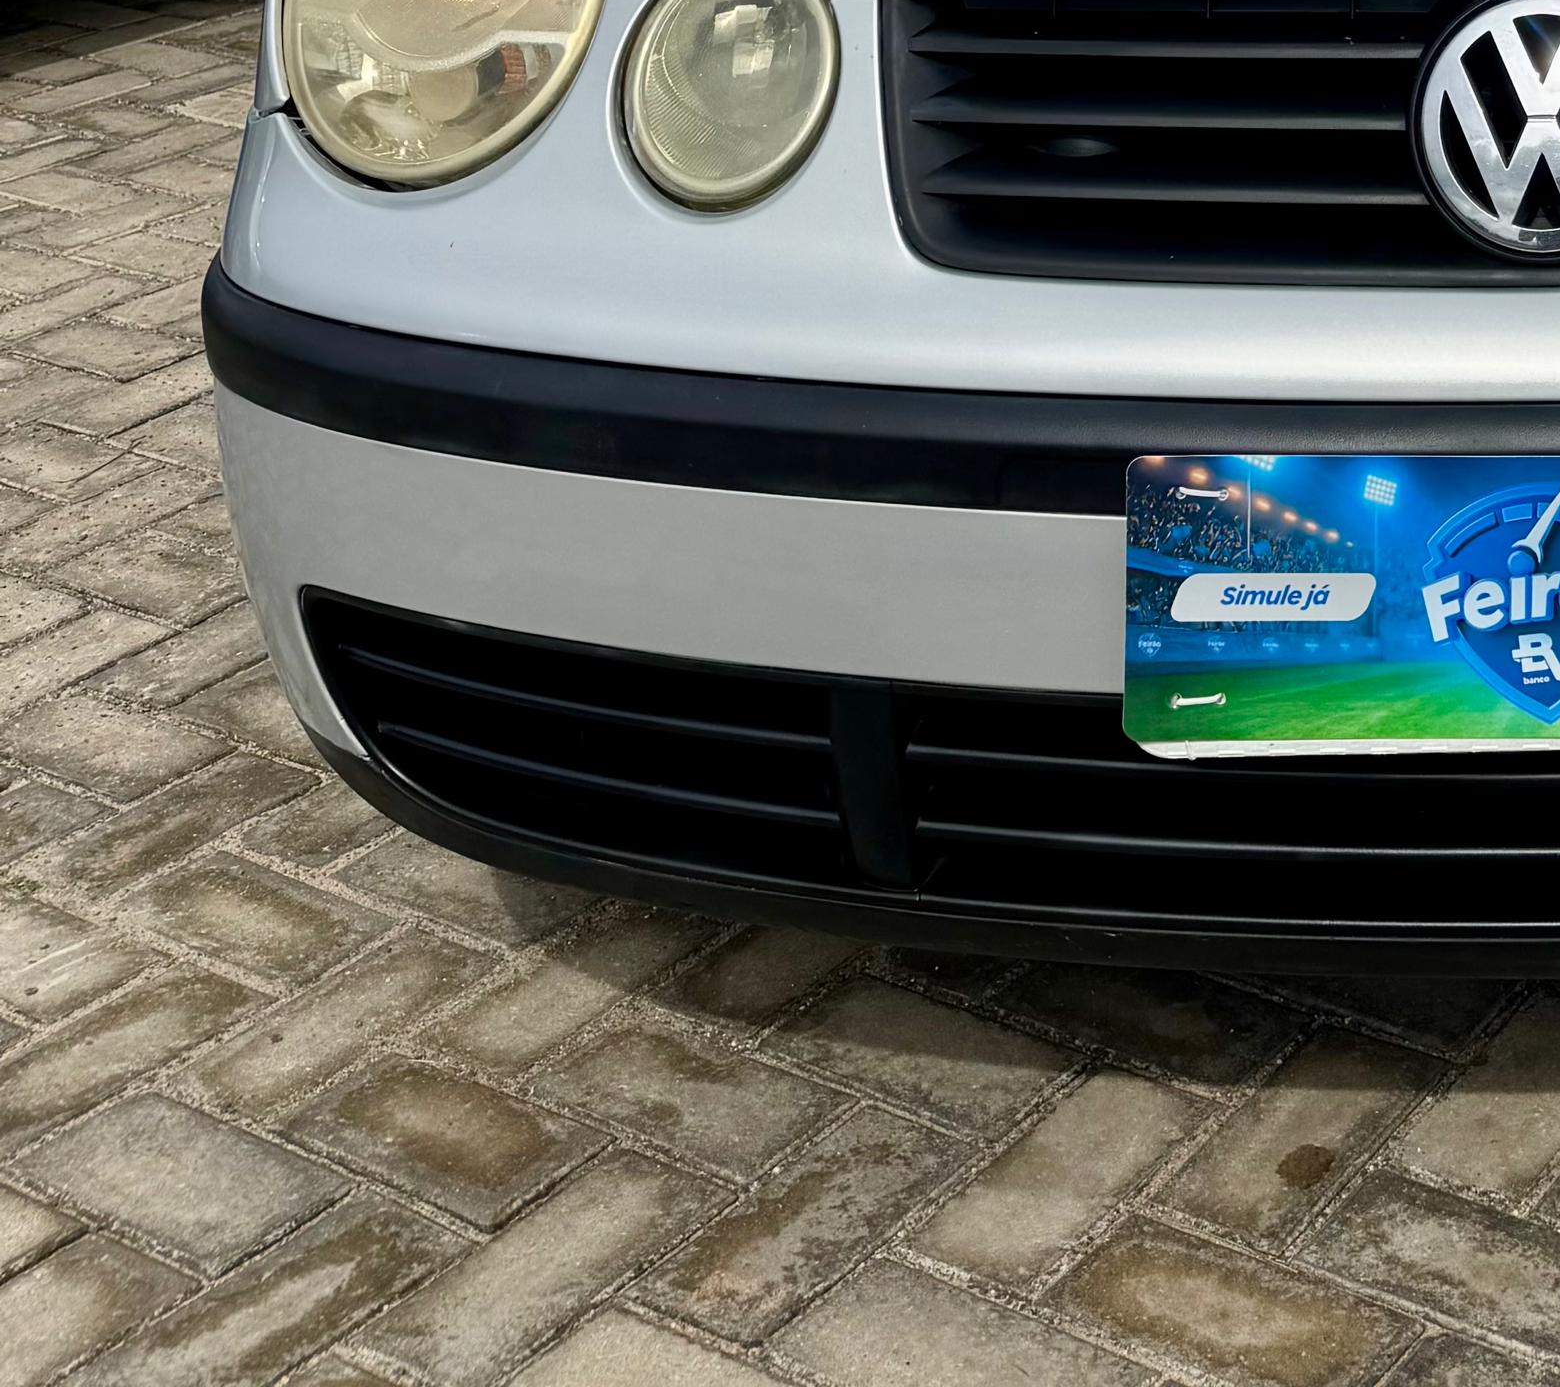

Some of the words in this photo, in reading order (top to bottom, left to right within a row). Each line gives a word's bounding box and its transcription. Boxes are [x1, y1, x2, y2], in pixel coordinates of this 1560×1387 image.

[1220, 584, 1302, 605] Simule
[1300, 584, 1330, 611] já
[1522, 675, 1551, 686] banco
